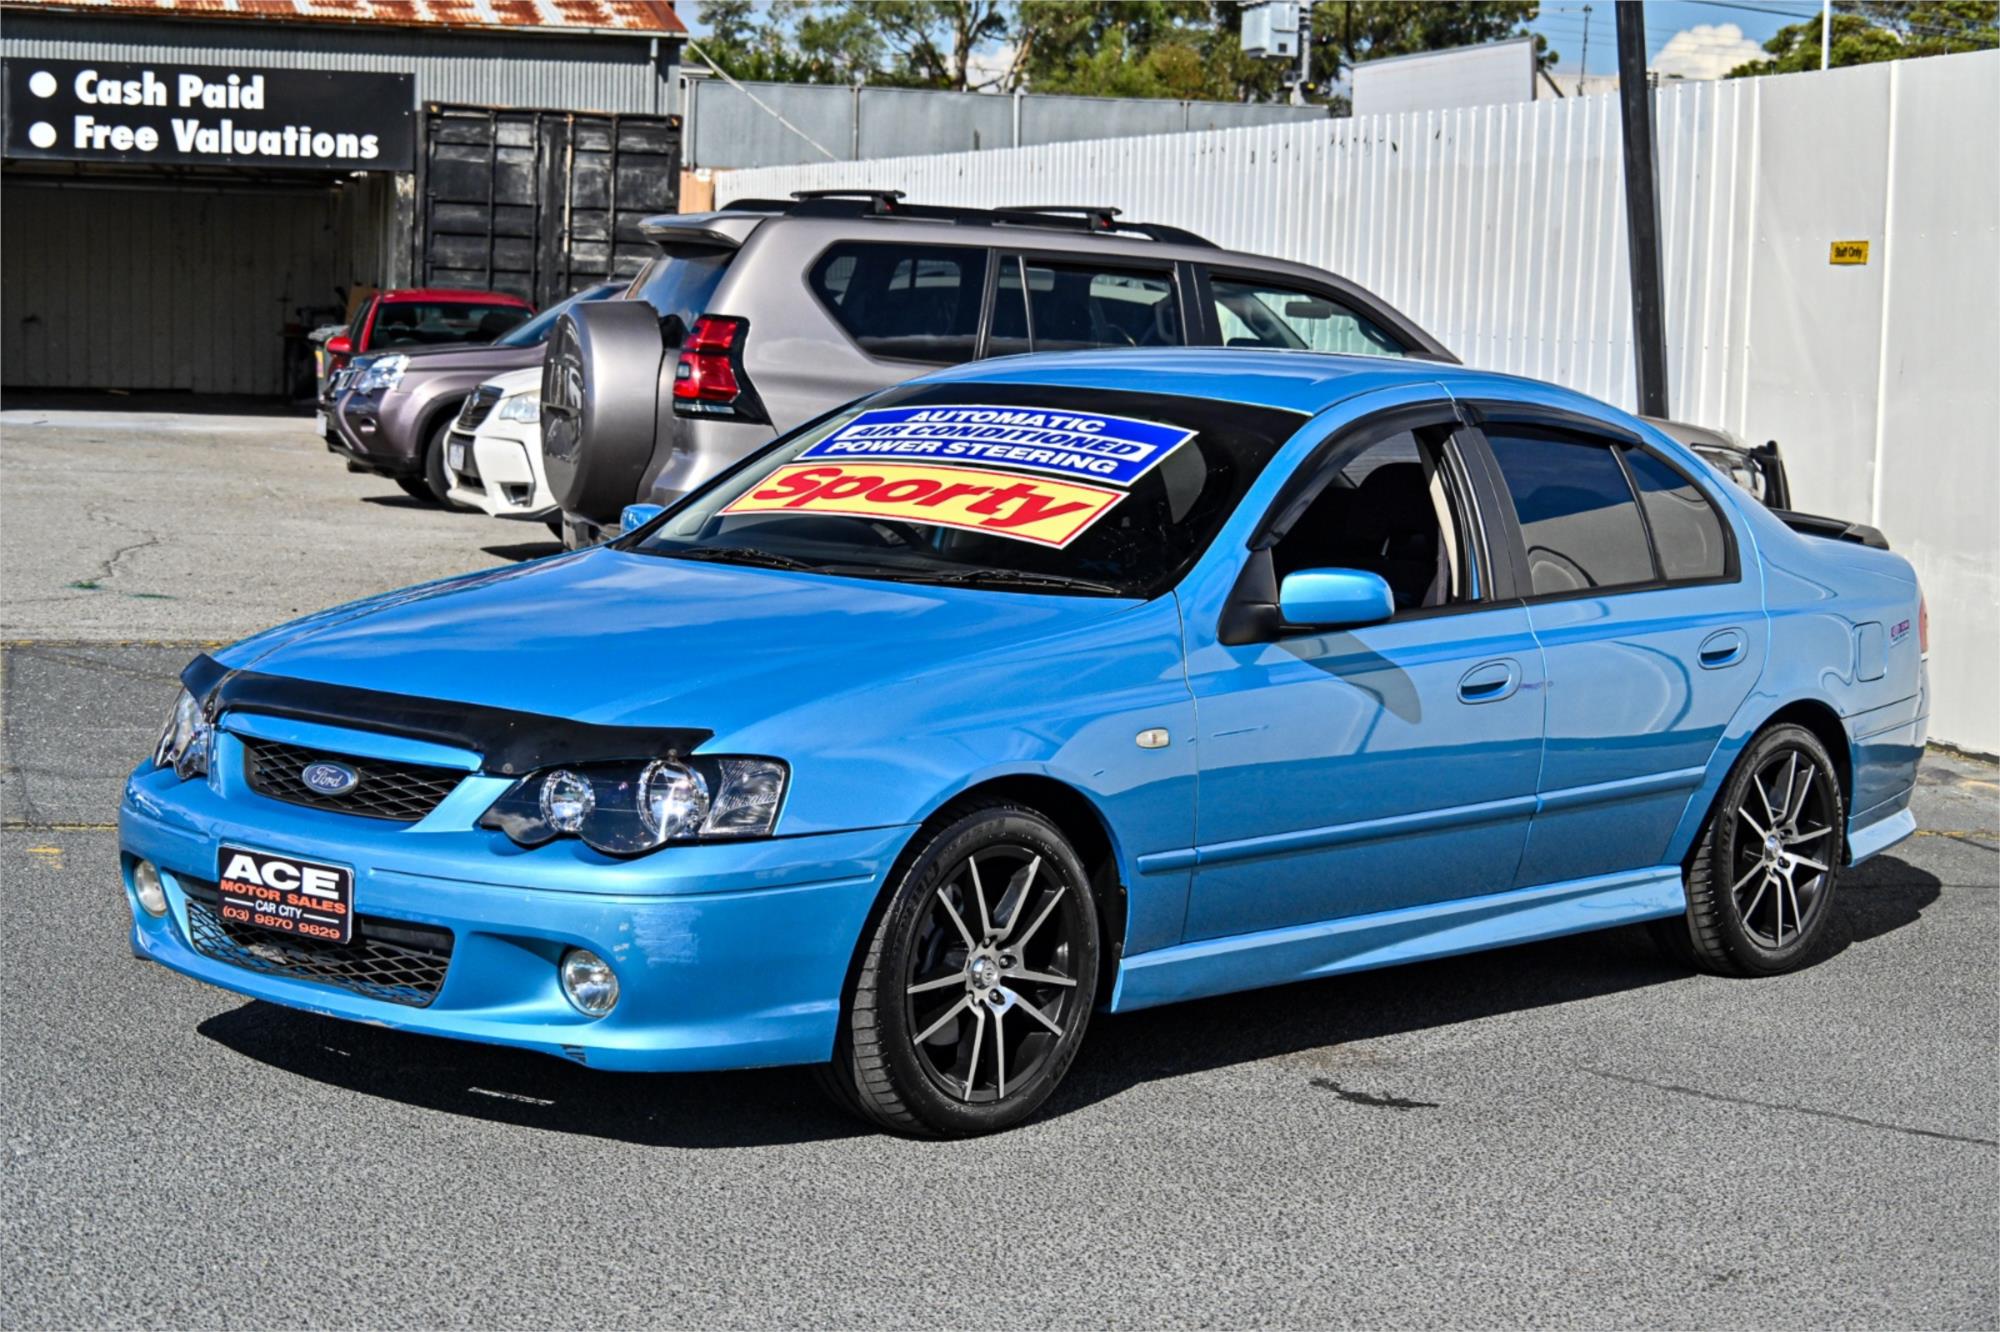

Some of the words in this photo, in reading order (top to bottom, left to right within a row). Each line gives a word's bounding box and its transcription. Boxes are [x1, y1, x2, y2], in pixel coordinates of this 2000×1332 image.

[74, 69, 167, 106] Cash
[178, 73, 265, 110] Paid
[74, 115, 159, 152] Free
[171, 118, 380, 160] Valuations
[1849, 246, 1863, 260] Only
[904, 410, 1106, 433] AUTOMATIC
[824, 440, 943, 453] POWER
[943, 442, 1118, 474] STEERING
[847, 424, 910, 438] AIR
[908, 424, 1142, 456] CONDITIONED
[753, 467, 1093, 528] Sporty
[311, 766, 344, 788] Ford
[223, 854, 339, 900] ACE
[221, 879, 281, 902] MOTOR
[287, 893, 346, 914] SALES
[255, 900, 276, 914] CAR
[278, 905, 303, 919] CITY
[223, 905, 250, 921] (03)
[254, 914, 294, 930] 9870
[298, 922, 341, 939] 9829
